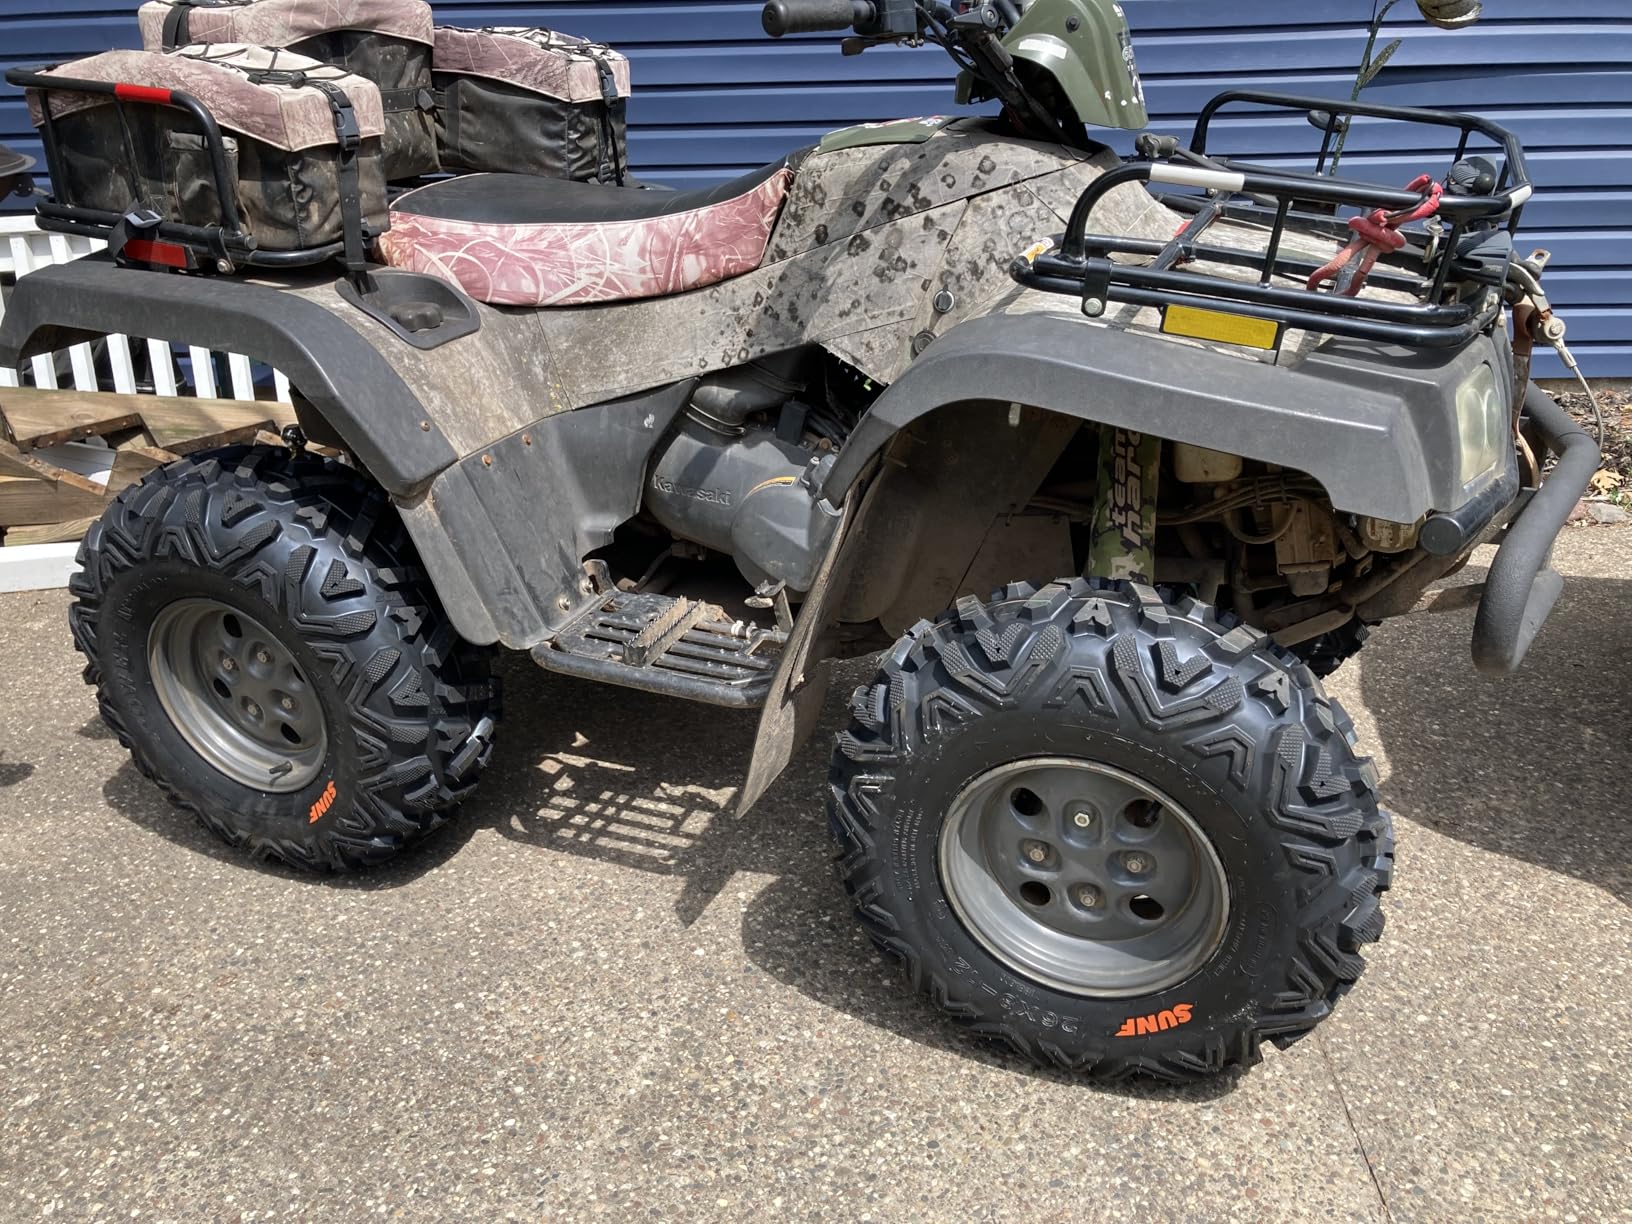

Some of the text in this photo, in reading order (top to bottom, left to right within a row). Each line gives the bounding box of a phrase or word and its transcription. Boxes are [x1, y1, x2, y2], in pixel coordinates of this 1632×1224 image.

[652, 474, 731, 505] Kawasaki
[308, 780, 337, 824] SUNF
[1115, 1003, 1194, 1037] SUNF
